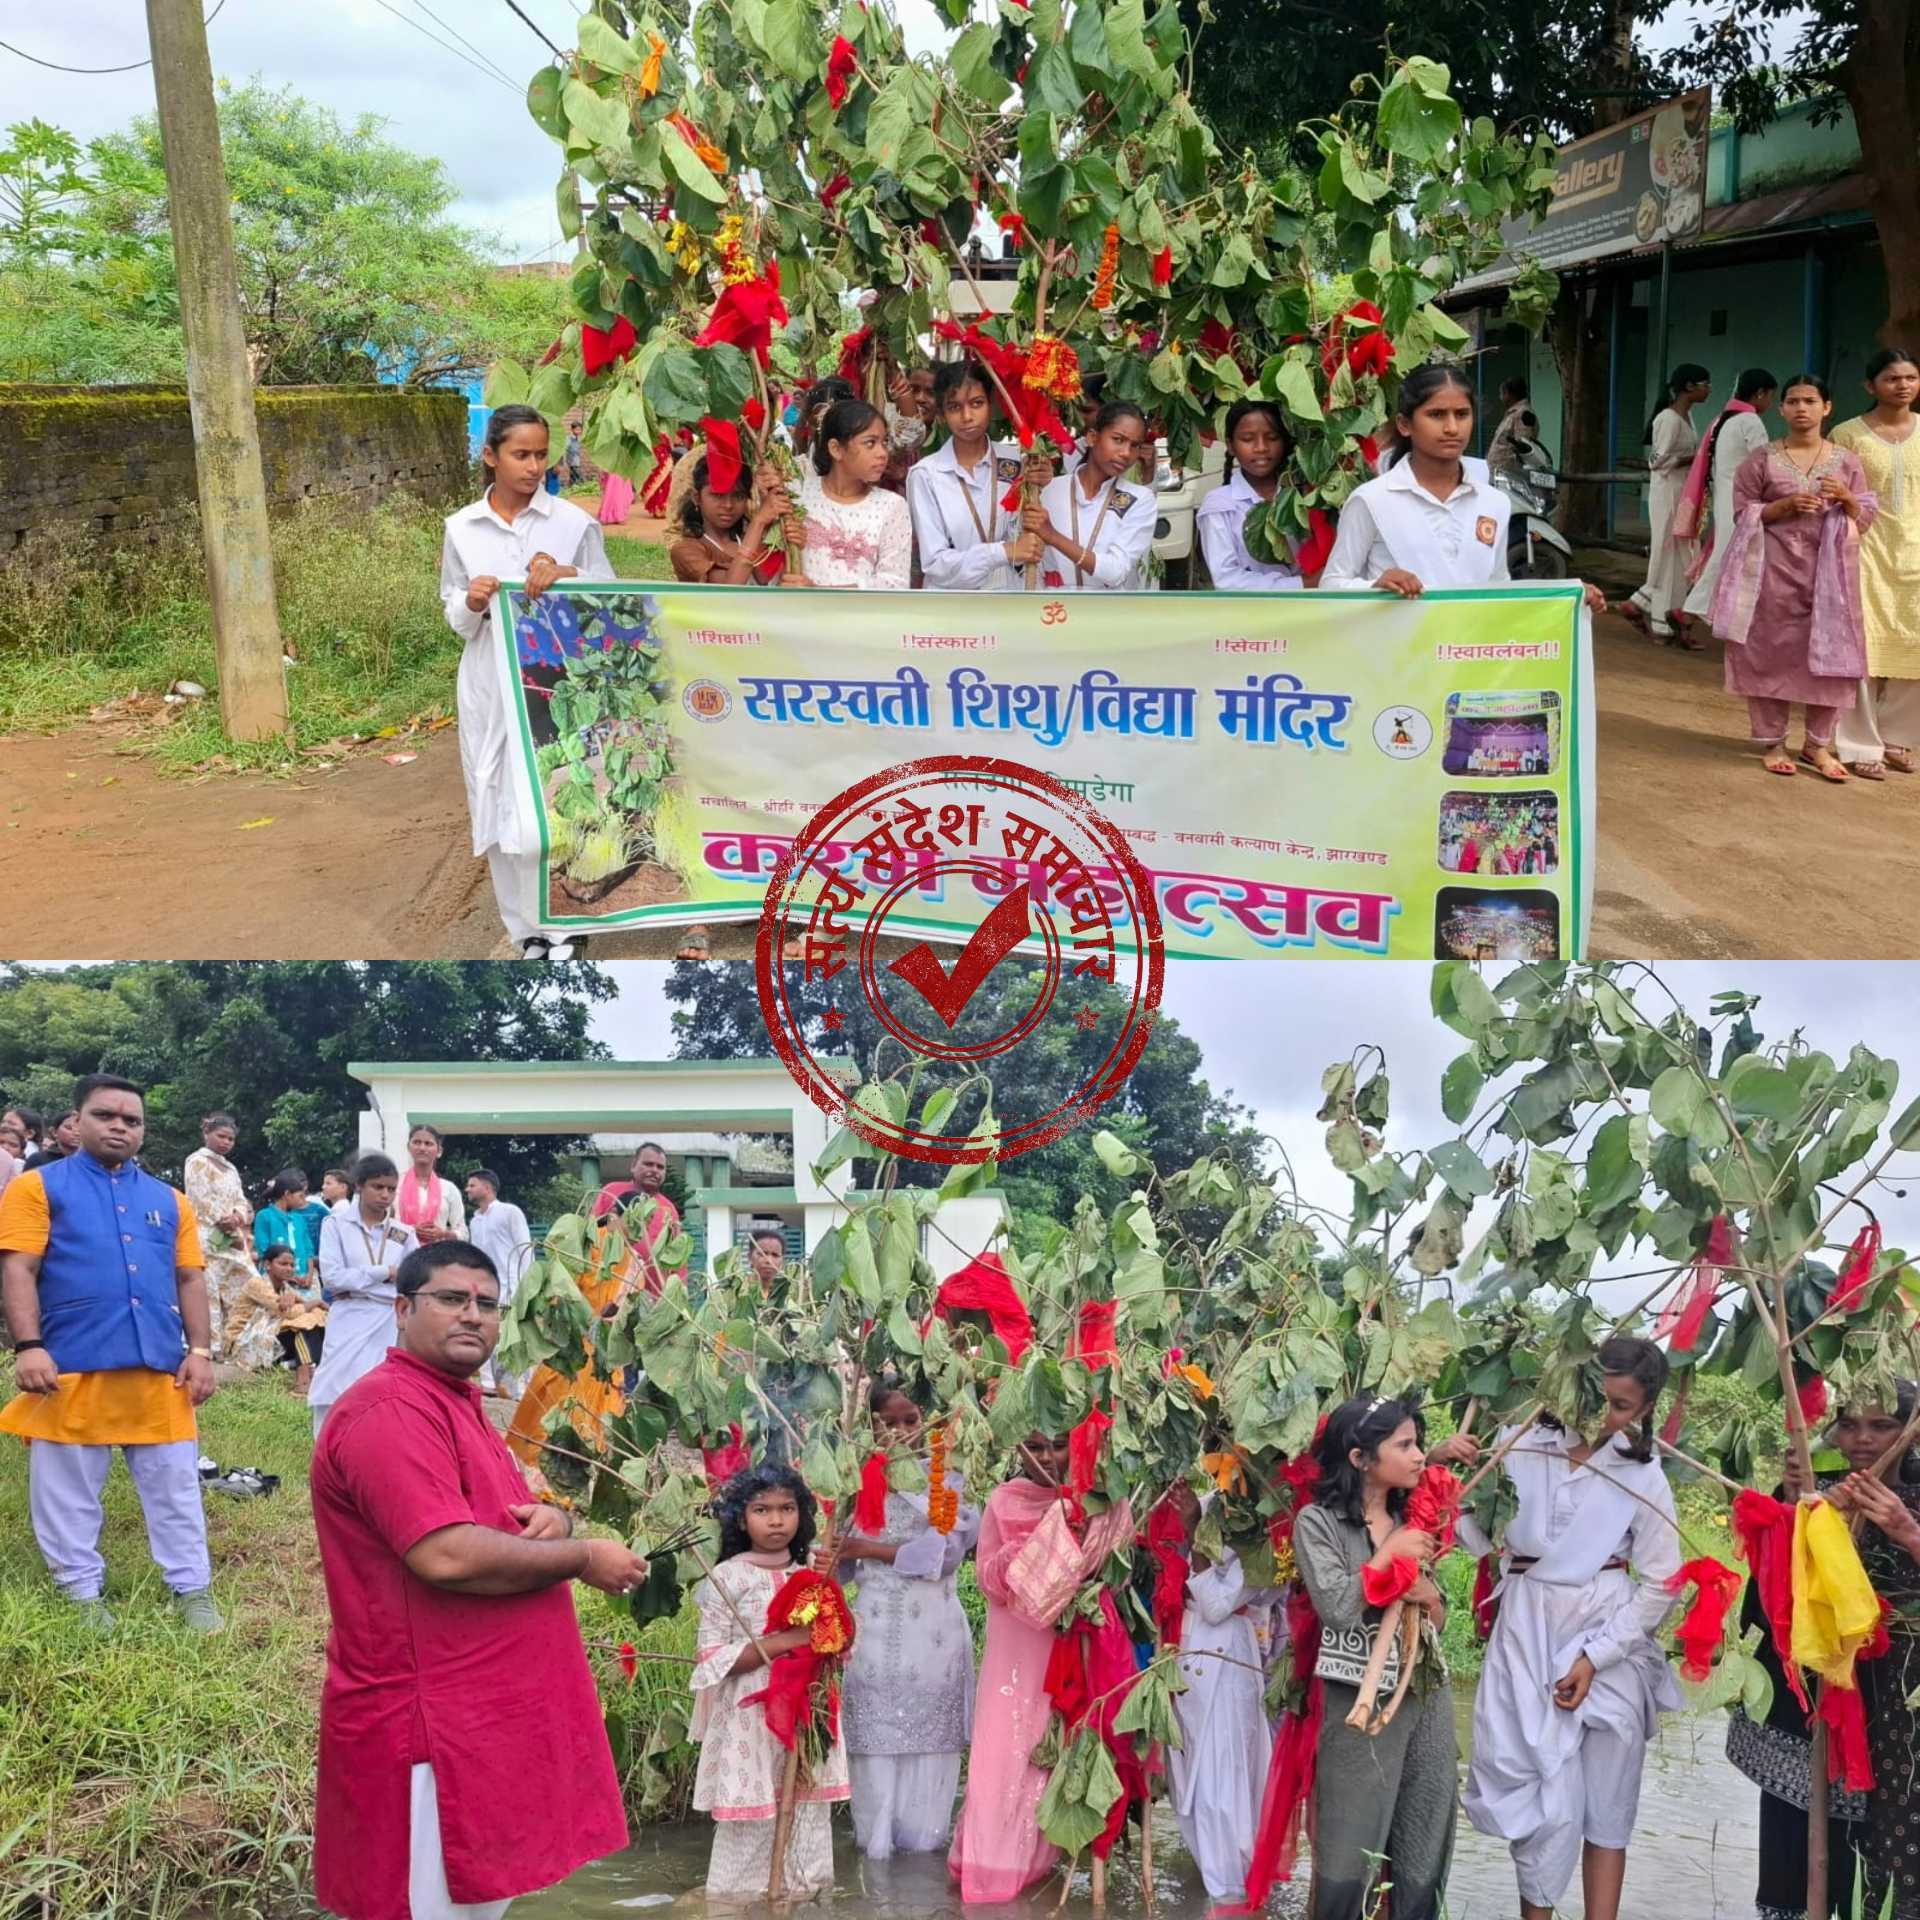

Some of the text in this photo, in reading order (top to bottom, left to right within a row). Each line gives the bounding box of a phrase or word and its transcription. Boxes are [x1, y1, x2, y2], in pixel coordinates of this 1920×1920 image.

[1551, 150, 1625, 197] allery
[738, 665, 930, 729] सरस्वती
[947, 667, 1197, 746] शिशु/विद्या
[1214, 673, 1352, 750] मंदिर
